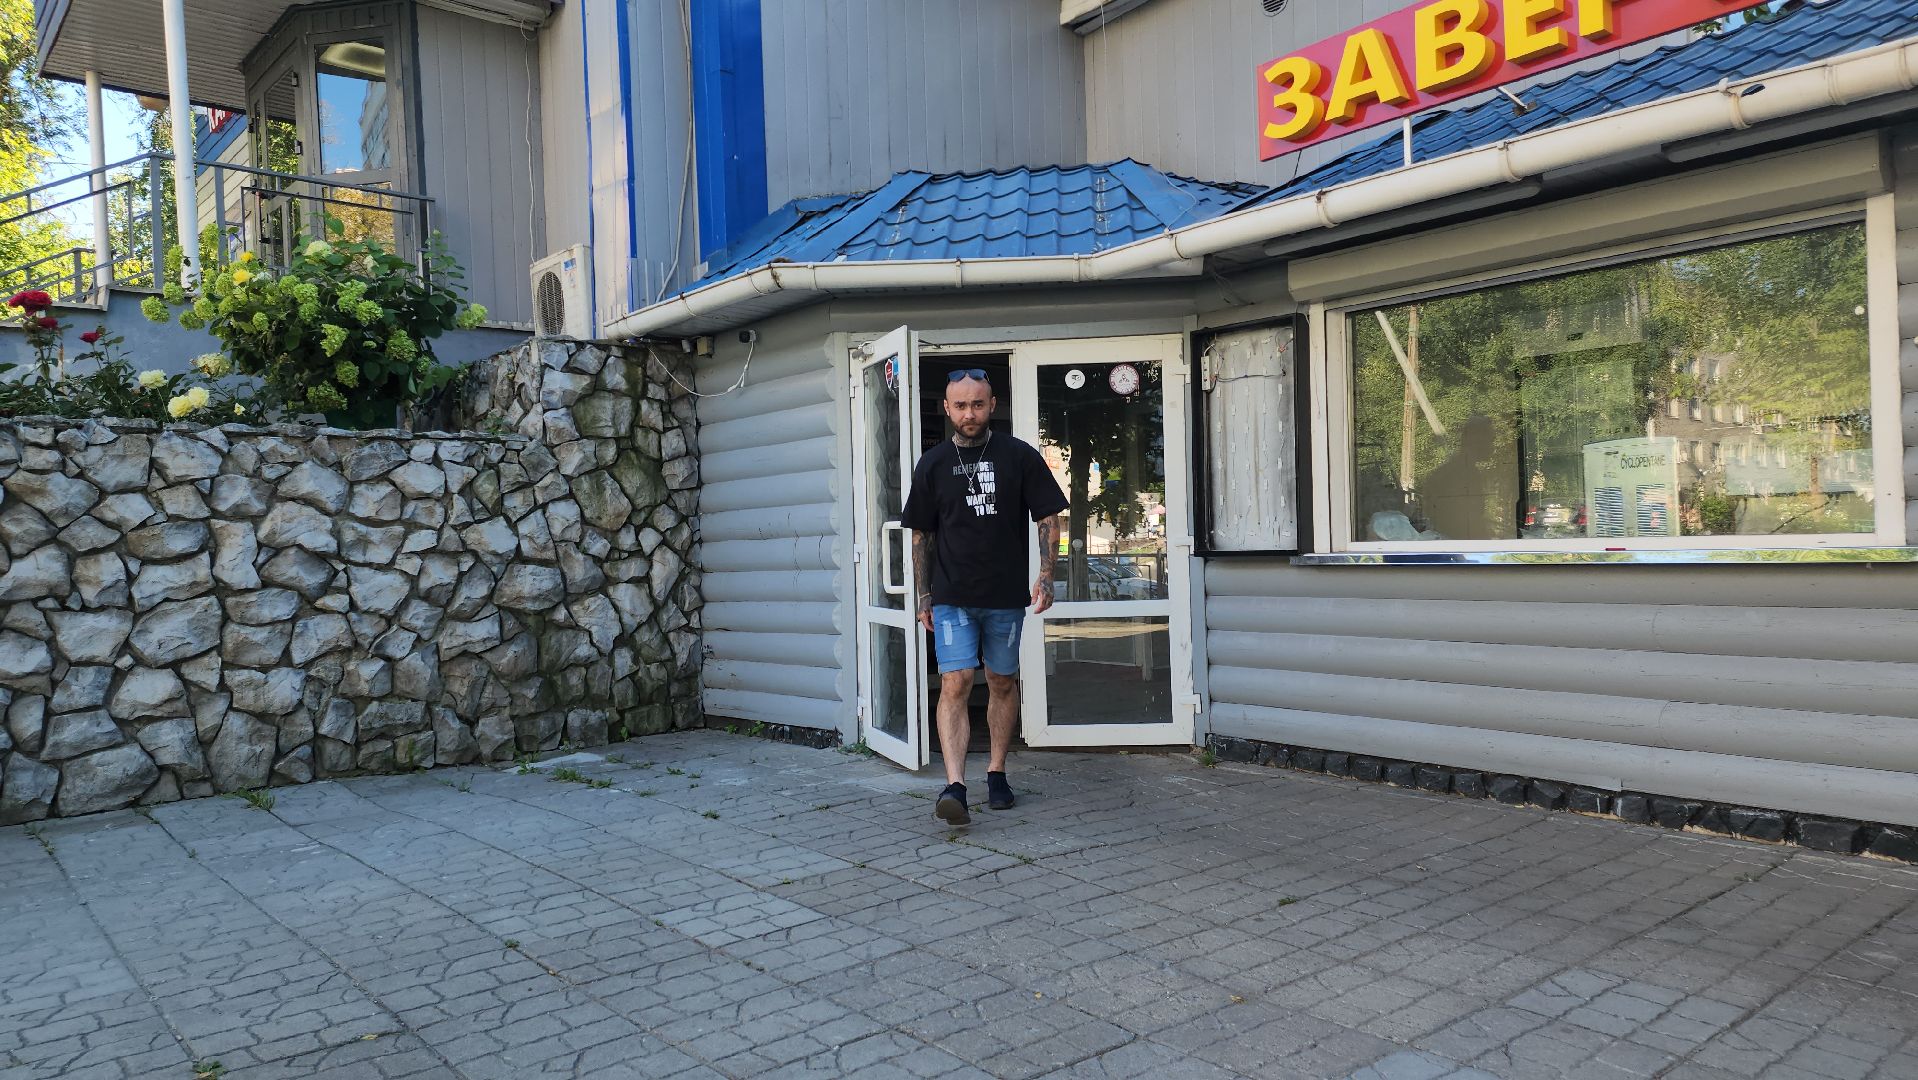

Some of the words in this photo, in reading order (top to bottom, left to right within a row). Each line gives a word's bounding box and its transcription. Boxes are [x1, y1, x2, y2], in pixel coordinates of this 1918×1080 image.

[1621, 455, 1666, 469] CYCLOPENTANE
[953, 462, 994, 475] REMEMBER
[977, 471, 994, 482] WHO
[980, 482, 995, 493] YOU
[966, 494, 996, 506] WANTED
[974, 505, 985, 516] TO
